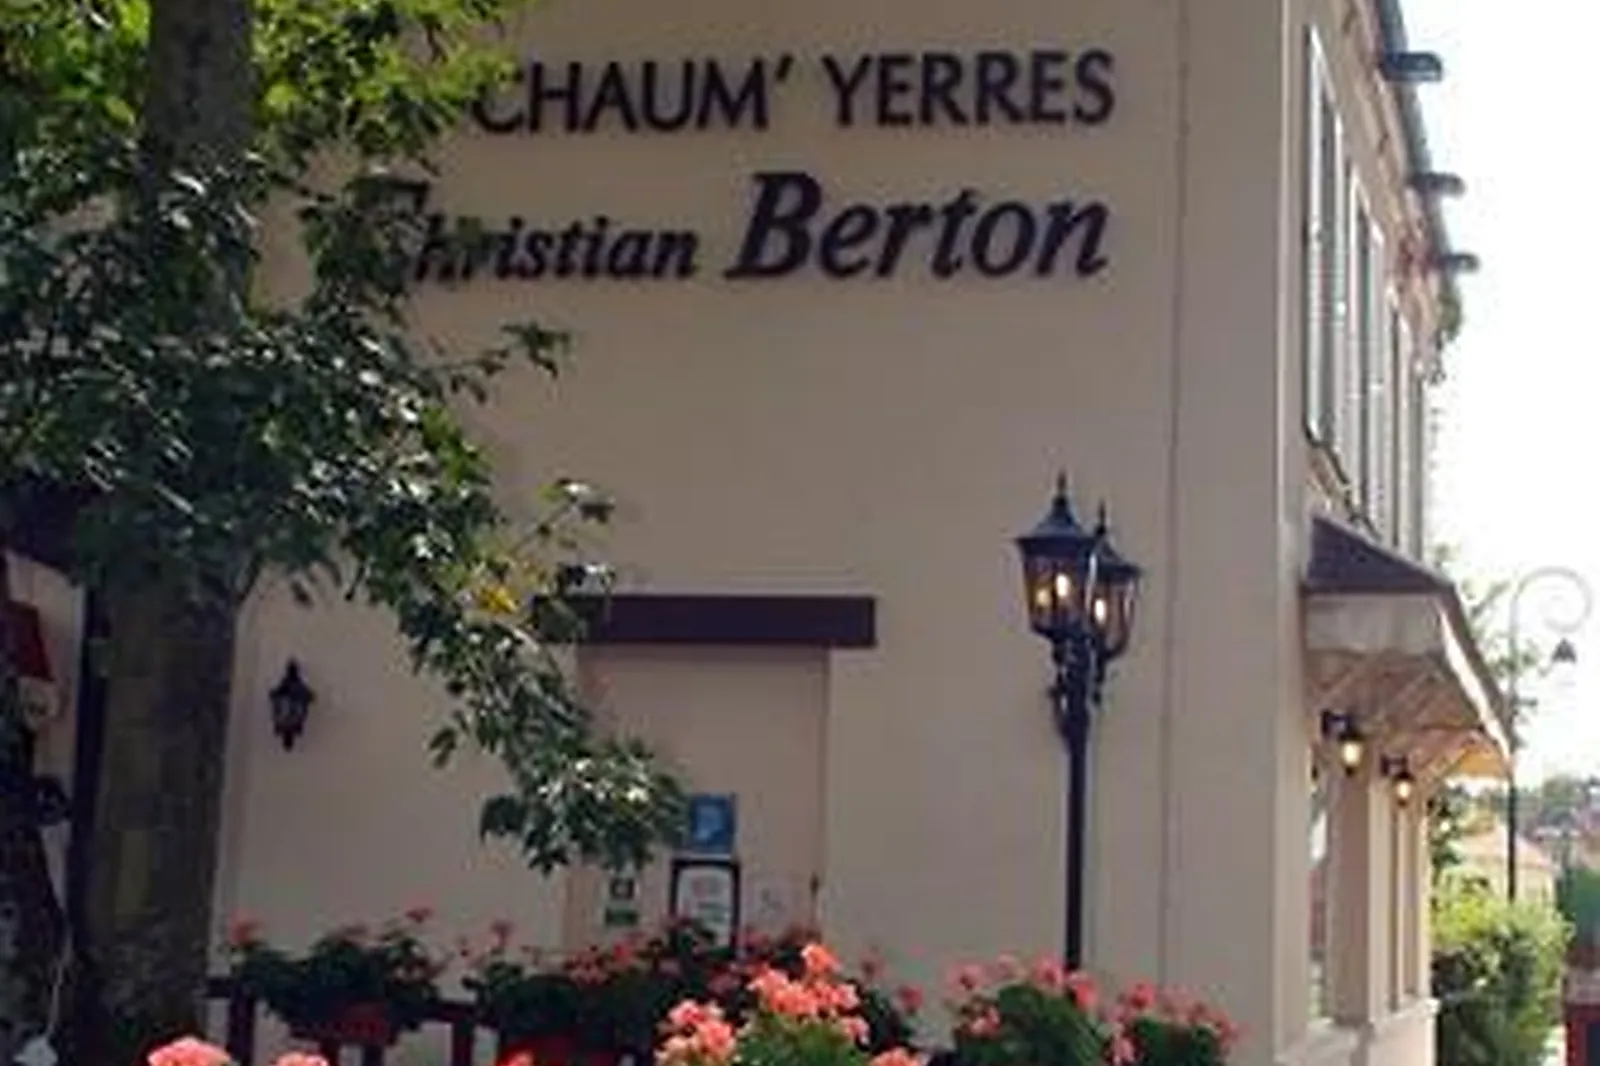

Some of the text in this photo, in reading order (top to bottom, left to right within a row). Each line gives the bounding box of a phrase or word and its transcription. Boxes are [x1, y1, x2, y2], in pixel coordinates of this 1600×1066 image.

[822, 50, 1116, 126] YERRES
[358, 171, 1110, 280] hristian Berton
